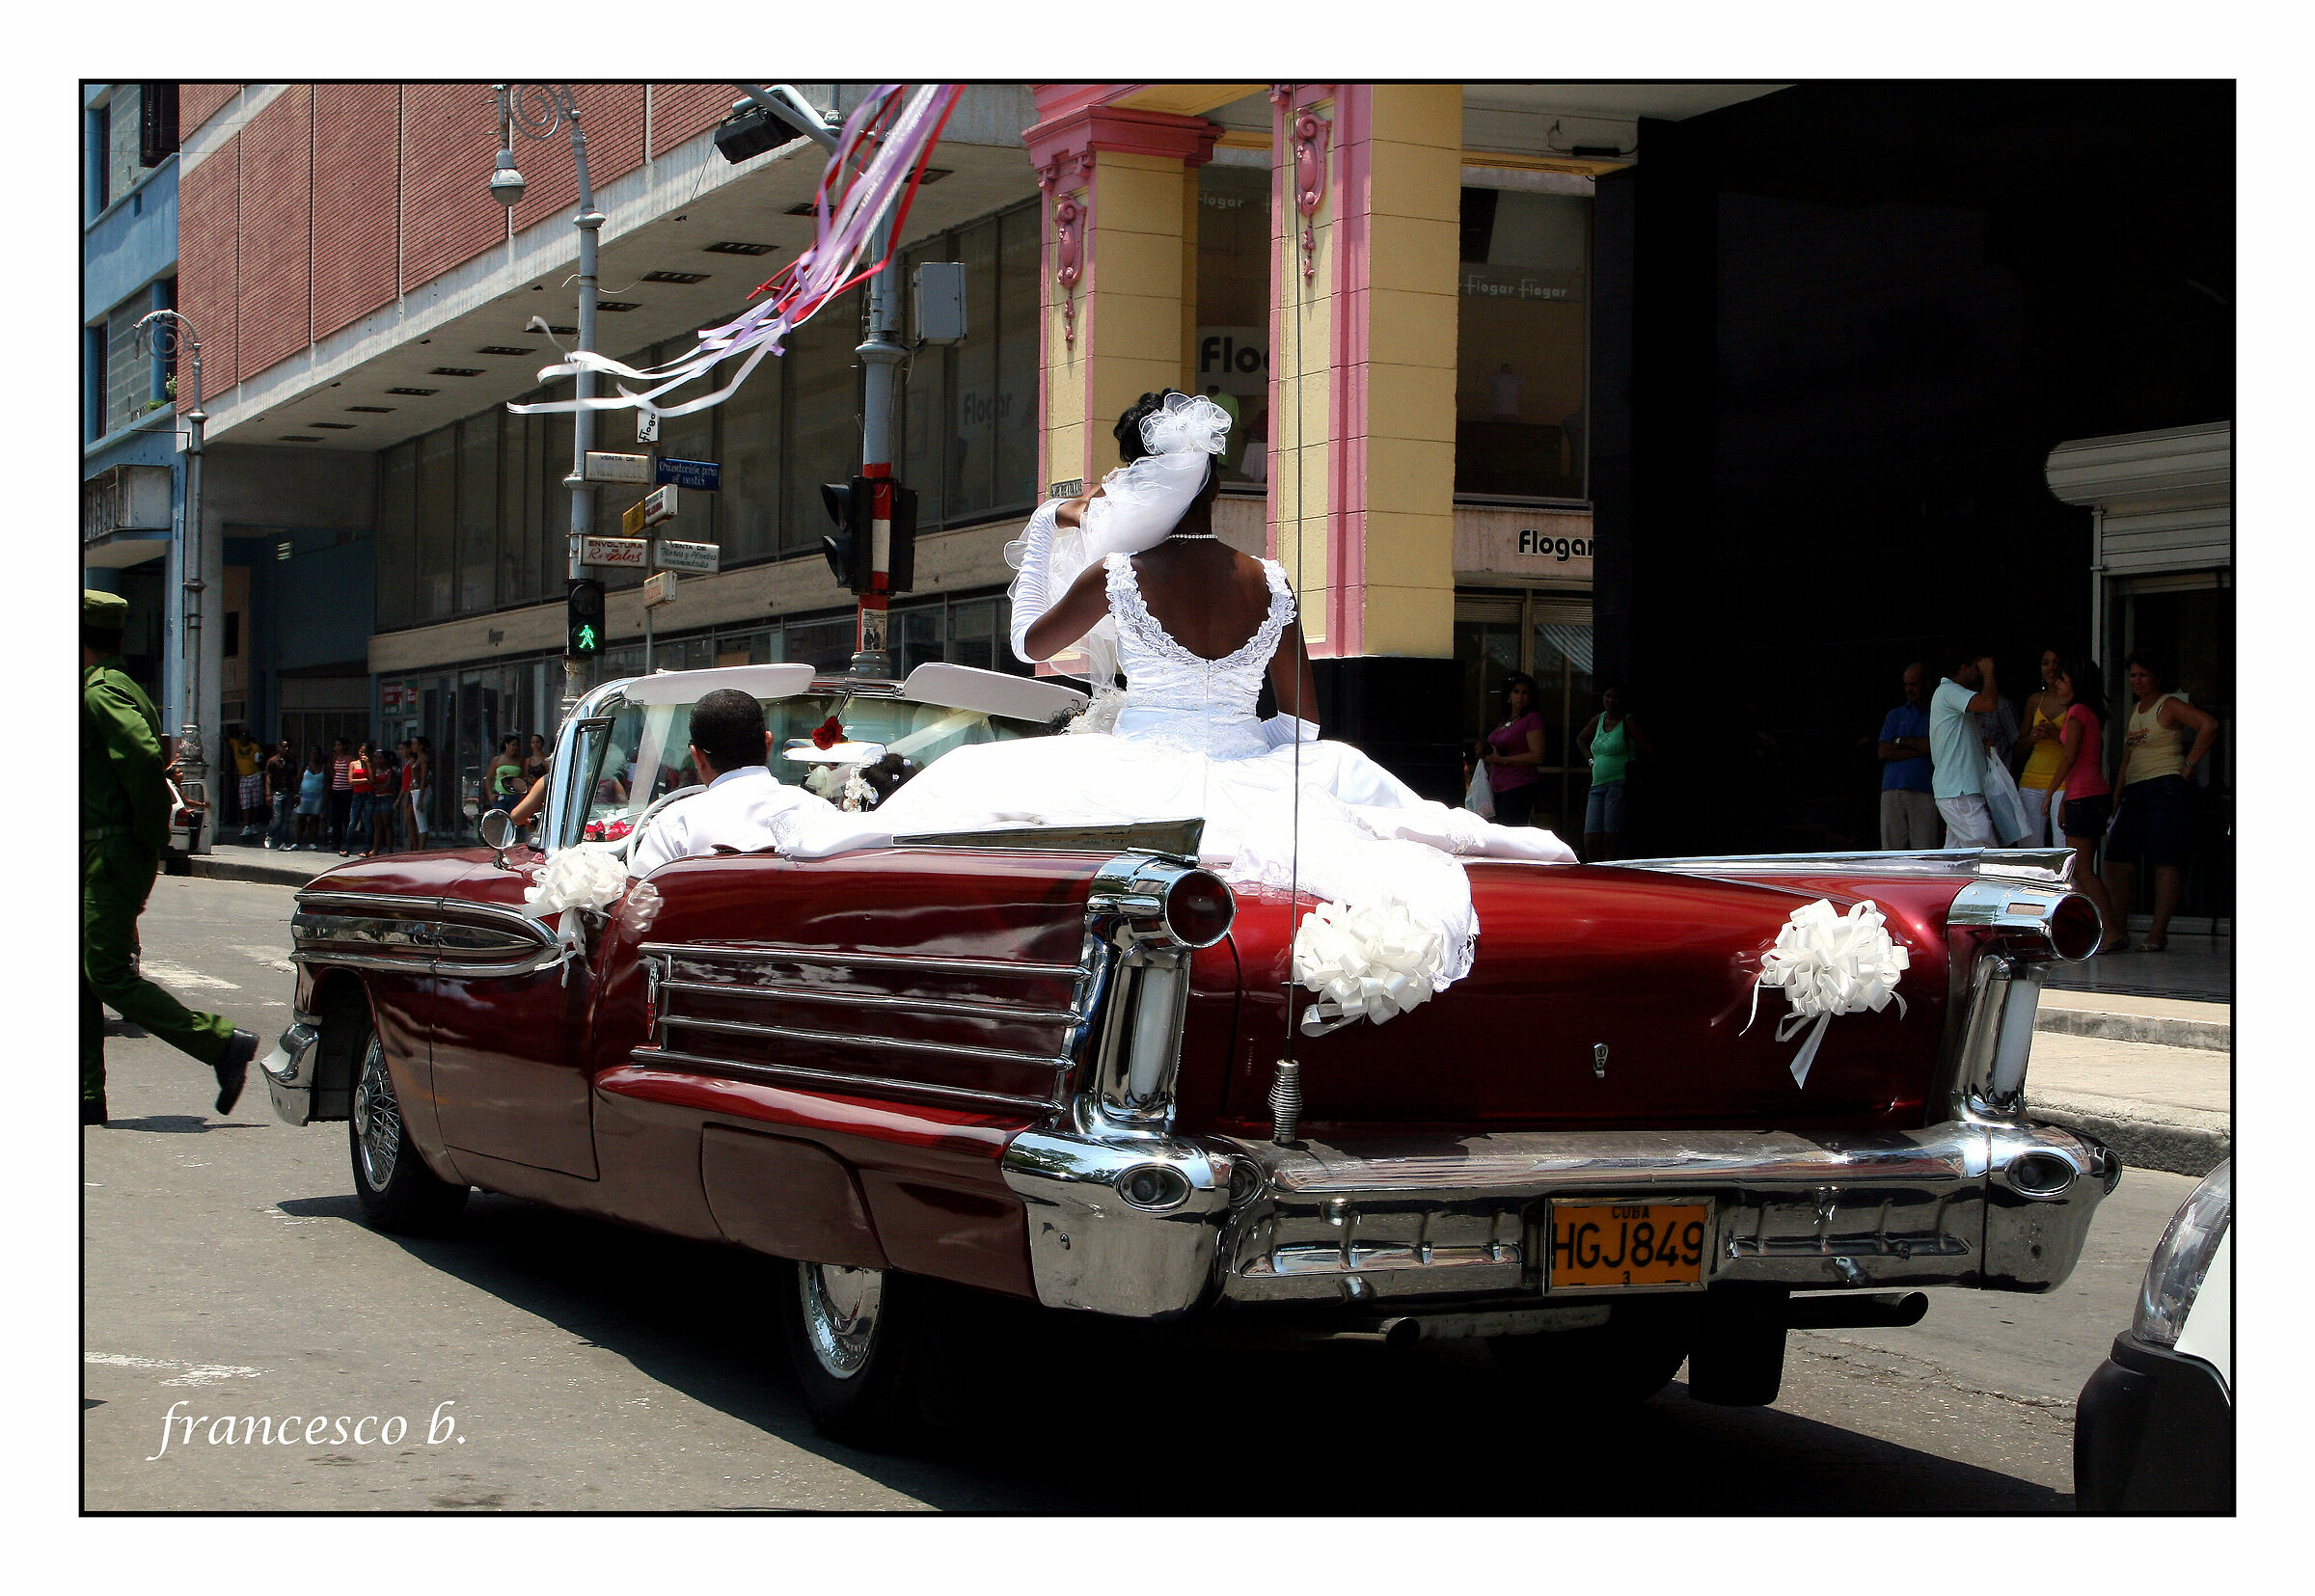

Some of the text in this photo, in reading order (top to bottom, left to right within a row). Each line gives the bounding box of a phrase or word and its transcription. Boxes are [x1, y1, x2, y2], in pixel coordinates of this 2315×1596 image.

[1464, 275, 1567, 300] Flogar Flogar
[588, 540, 643, 550] ENVOLTURA
[1612, 1205, 1650, 1220] CUBA
[1551, 1221, 1705, 1270] HGJ849
[1621, 1270, 1631, 1285] 3
